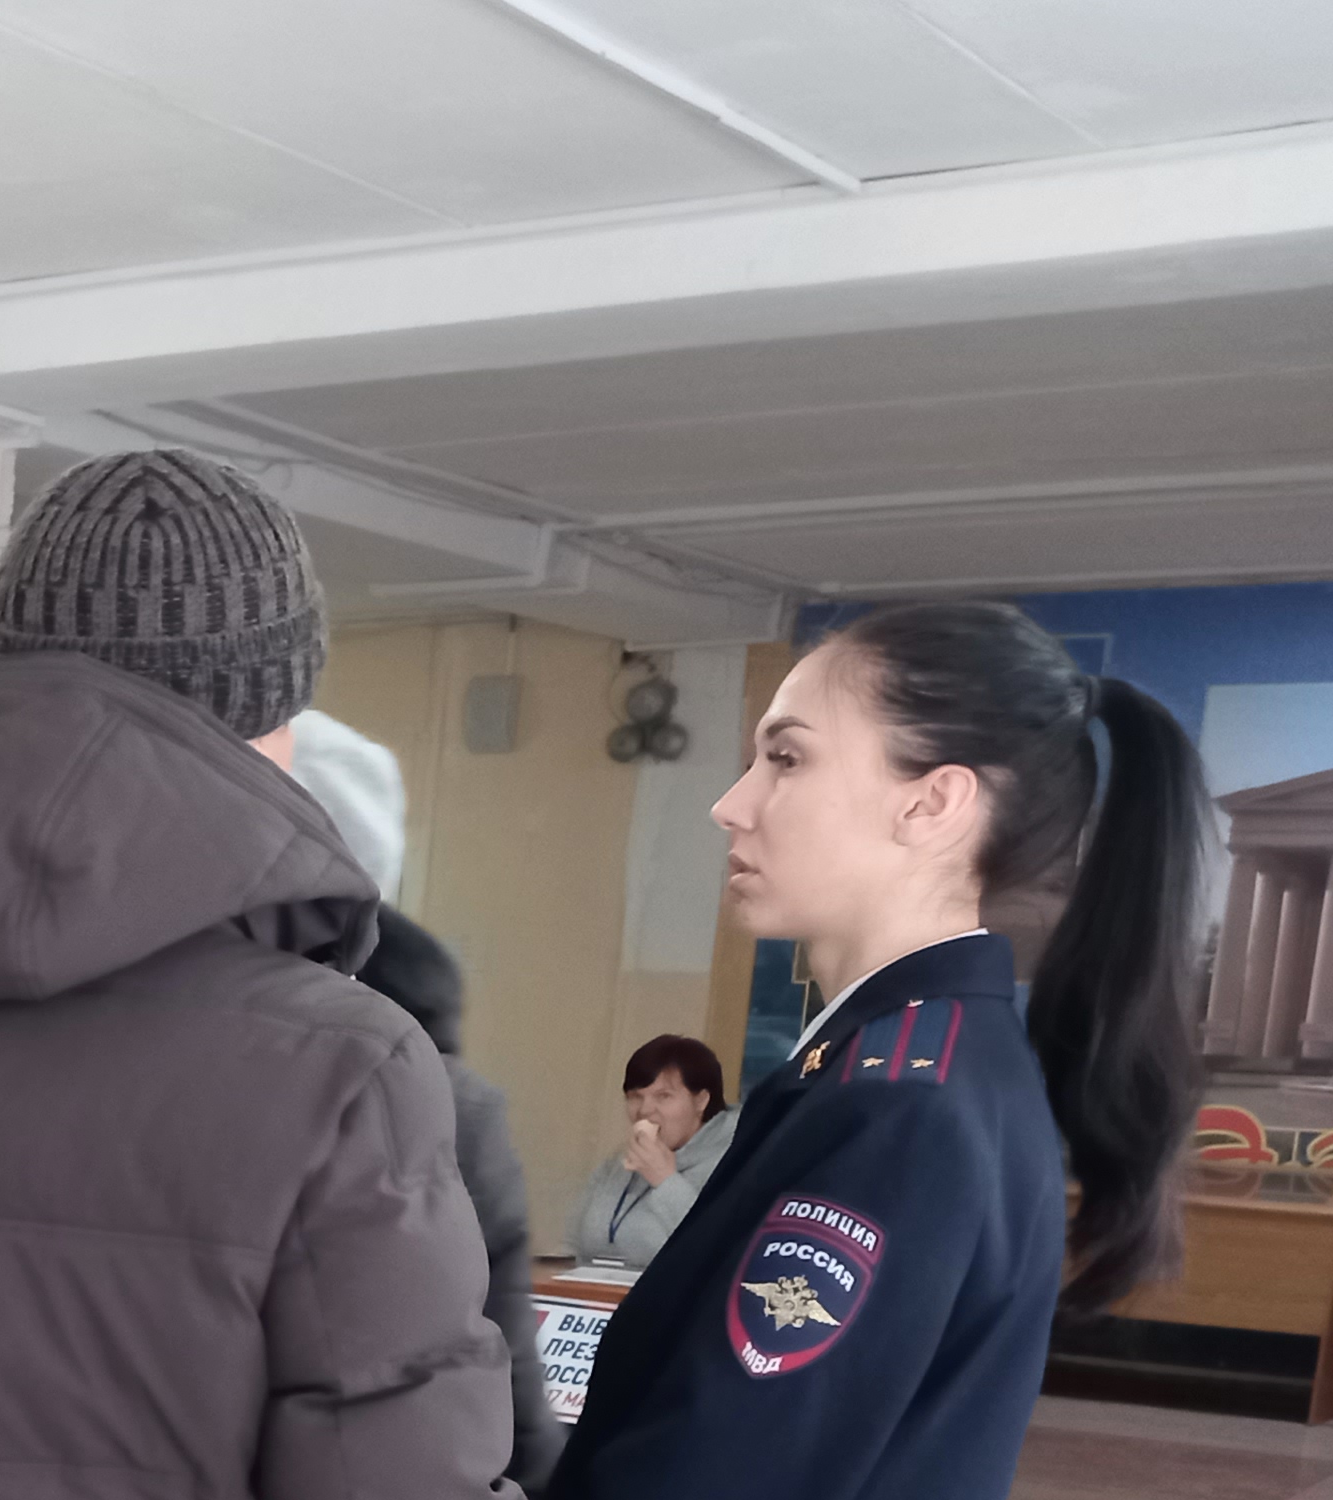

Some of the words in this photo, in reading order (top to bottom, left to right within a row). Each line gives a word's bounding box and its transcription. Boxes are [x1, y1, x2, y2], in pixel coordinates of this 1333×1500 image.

[781, 1201, 877, 1252] ПОЛИЦИЯ
[763, 1241, 855, 1292] РОССИЯ
[741, 1341, 782, 1375] МВД
